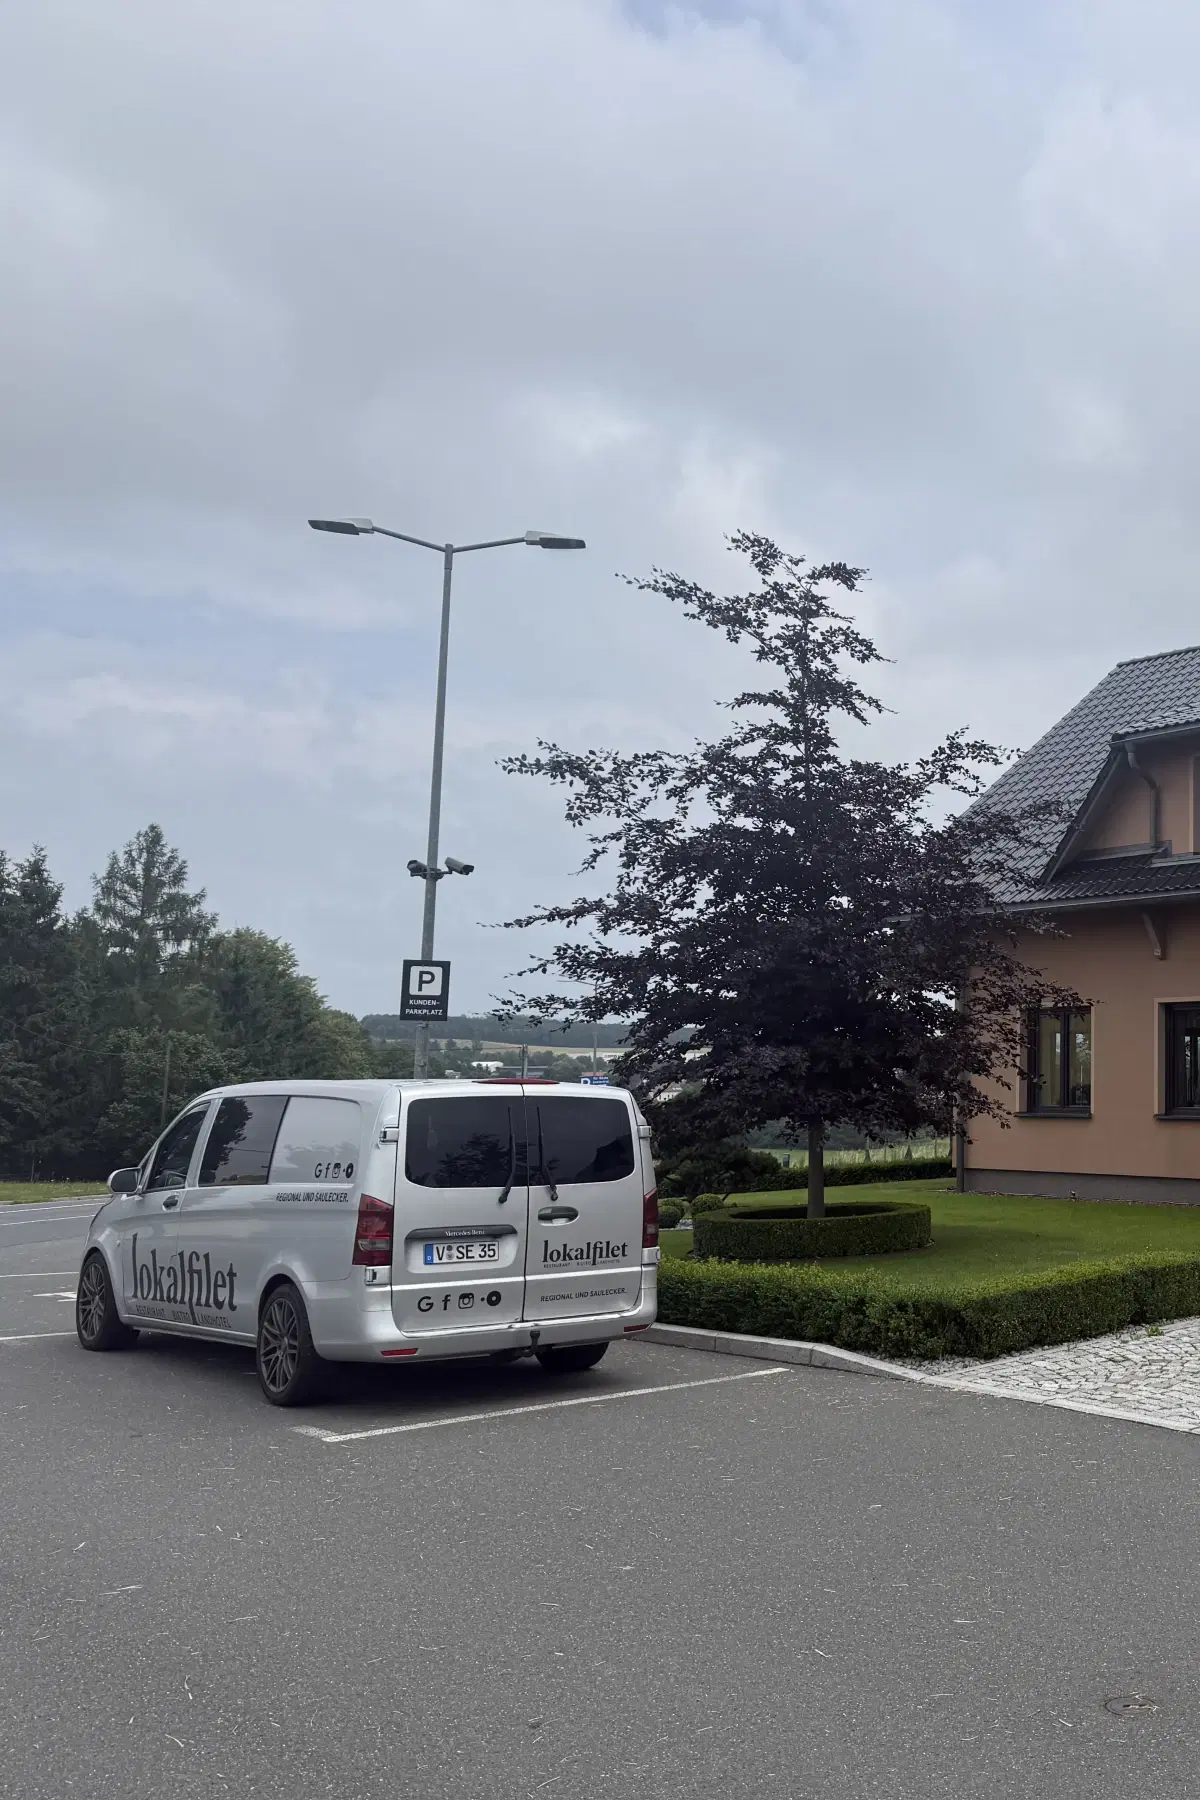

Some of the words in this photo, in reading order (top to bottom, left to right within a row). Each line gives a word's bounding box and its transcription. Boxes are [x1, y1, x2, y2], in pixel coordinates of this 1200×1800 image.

[418, 970, 436, 992] P
[276, 1192, 302, 1202] REGIONAL
[302, 1192, 315, 1202] UND
[436, 1246, 445, 1261] V
[456, 1245, 475, 1260] SE
[478, 1243, 496, 1259] 35
[542, 1239, 629, 1266] lokalfilet
[132, 1232, 238, 1325] lokalfilet
[540, 1292, 574, 1302] REGIONAL
[575, 1291, 589, 1299] UND
